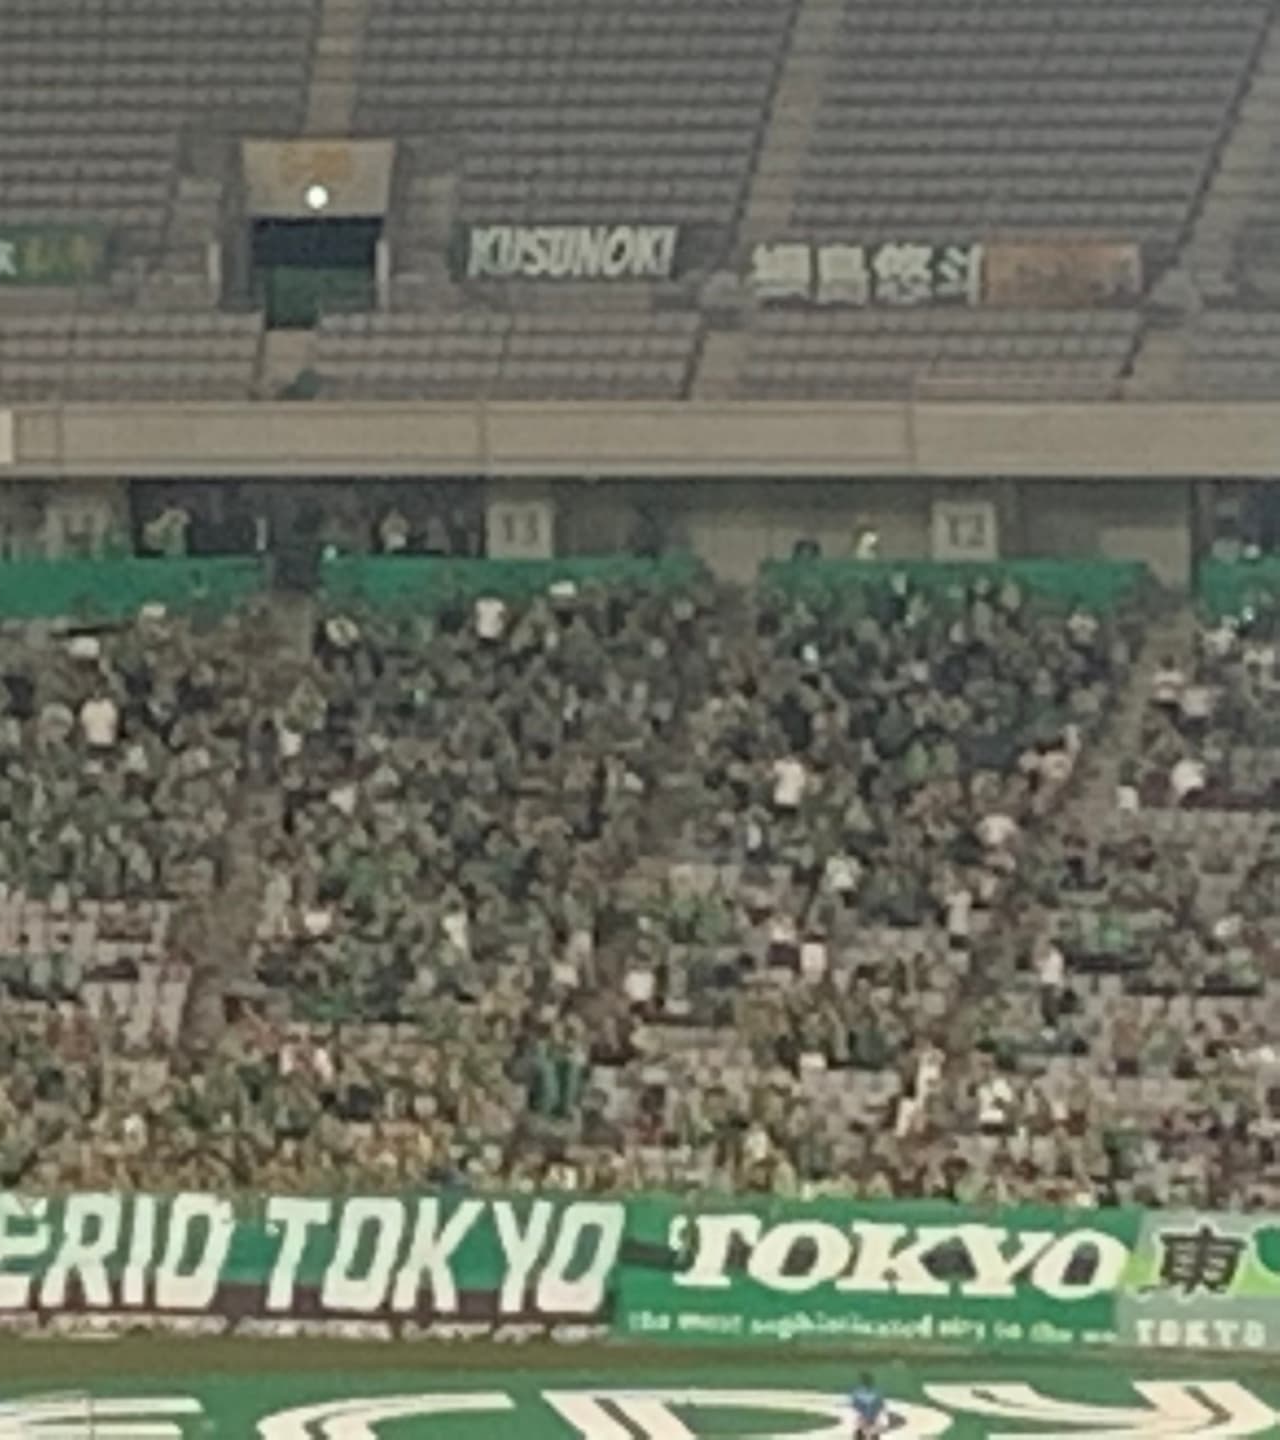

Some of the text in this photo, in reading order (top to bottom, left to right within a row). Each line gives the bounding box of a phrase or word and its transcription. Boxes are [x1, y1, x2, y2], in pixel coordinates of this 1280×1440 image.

[265, 1196, 627, 1312] TOKYO
[669, 1213, 1133, 1299] TOKYO
[1138, 1223, 1247, 1296] 東
